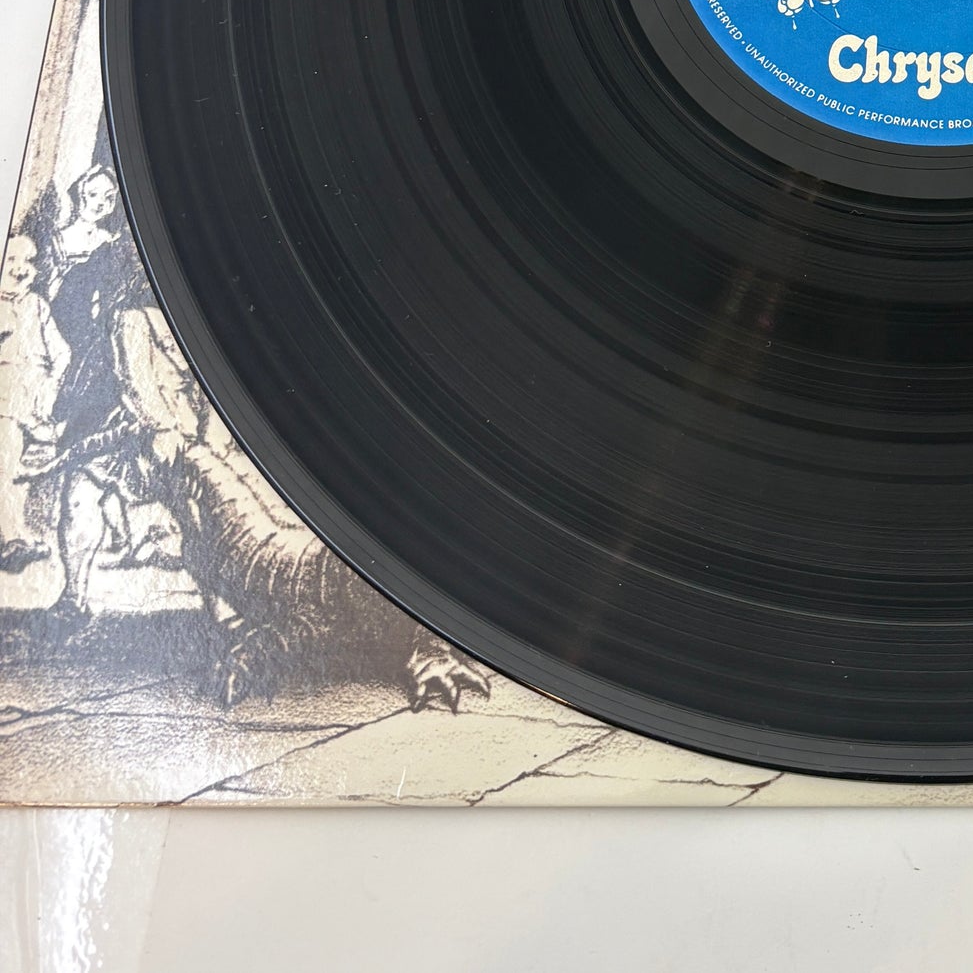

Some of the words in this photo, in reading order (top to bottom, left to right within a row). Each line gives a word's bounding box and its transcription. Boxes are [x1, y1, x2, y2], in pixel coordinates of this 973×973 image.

[745, 43, 815, 98] UNAUTHORIZED
[817, 94, 856, 115] PUBLIC
[858, 109, 944, 129] PERFORMANCE
